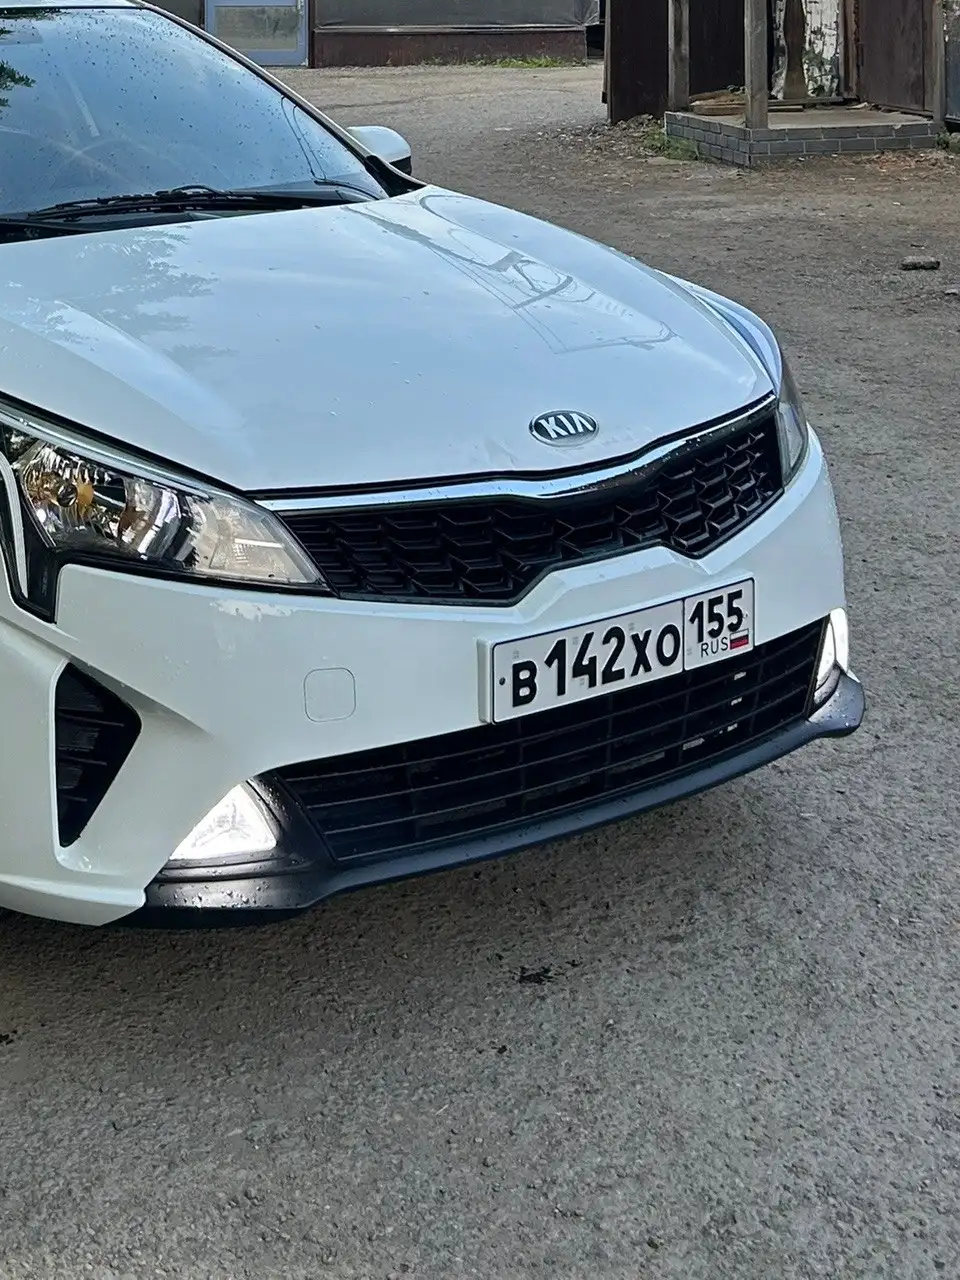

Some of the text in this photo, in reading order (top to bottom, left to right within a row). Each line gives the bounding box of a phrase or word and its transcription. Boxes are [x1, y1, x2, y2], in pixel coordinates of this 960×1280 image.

[537, 412, 595, 440] KIA
[688, 589, 744, 644] 155
[700, 636, 730, 658] RUS
